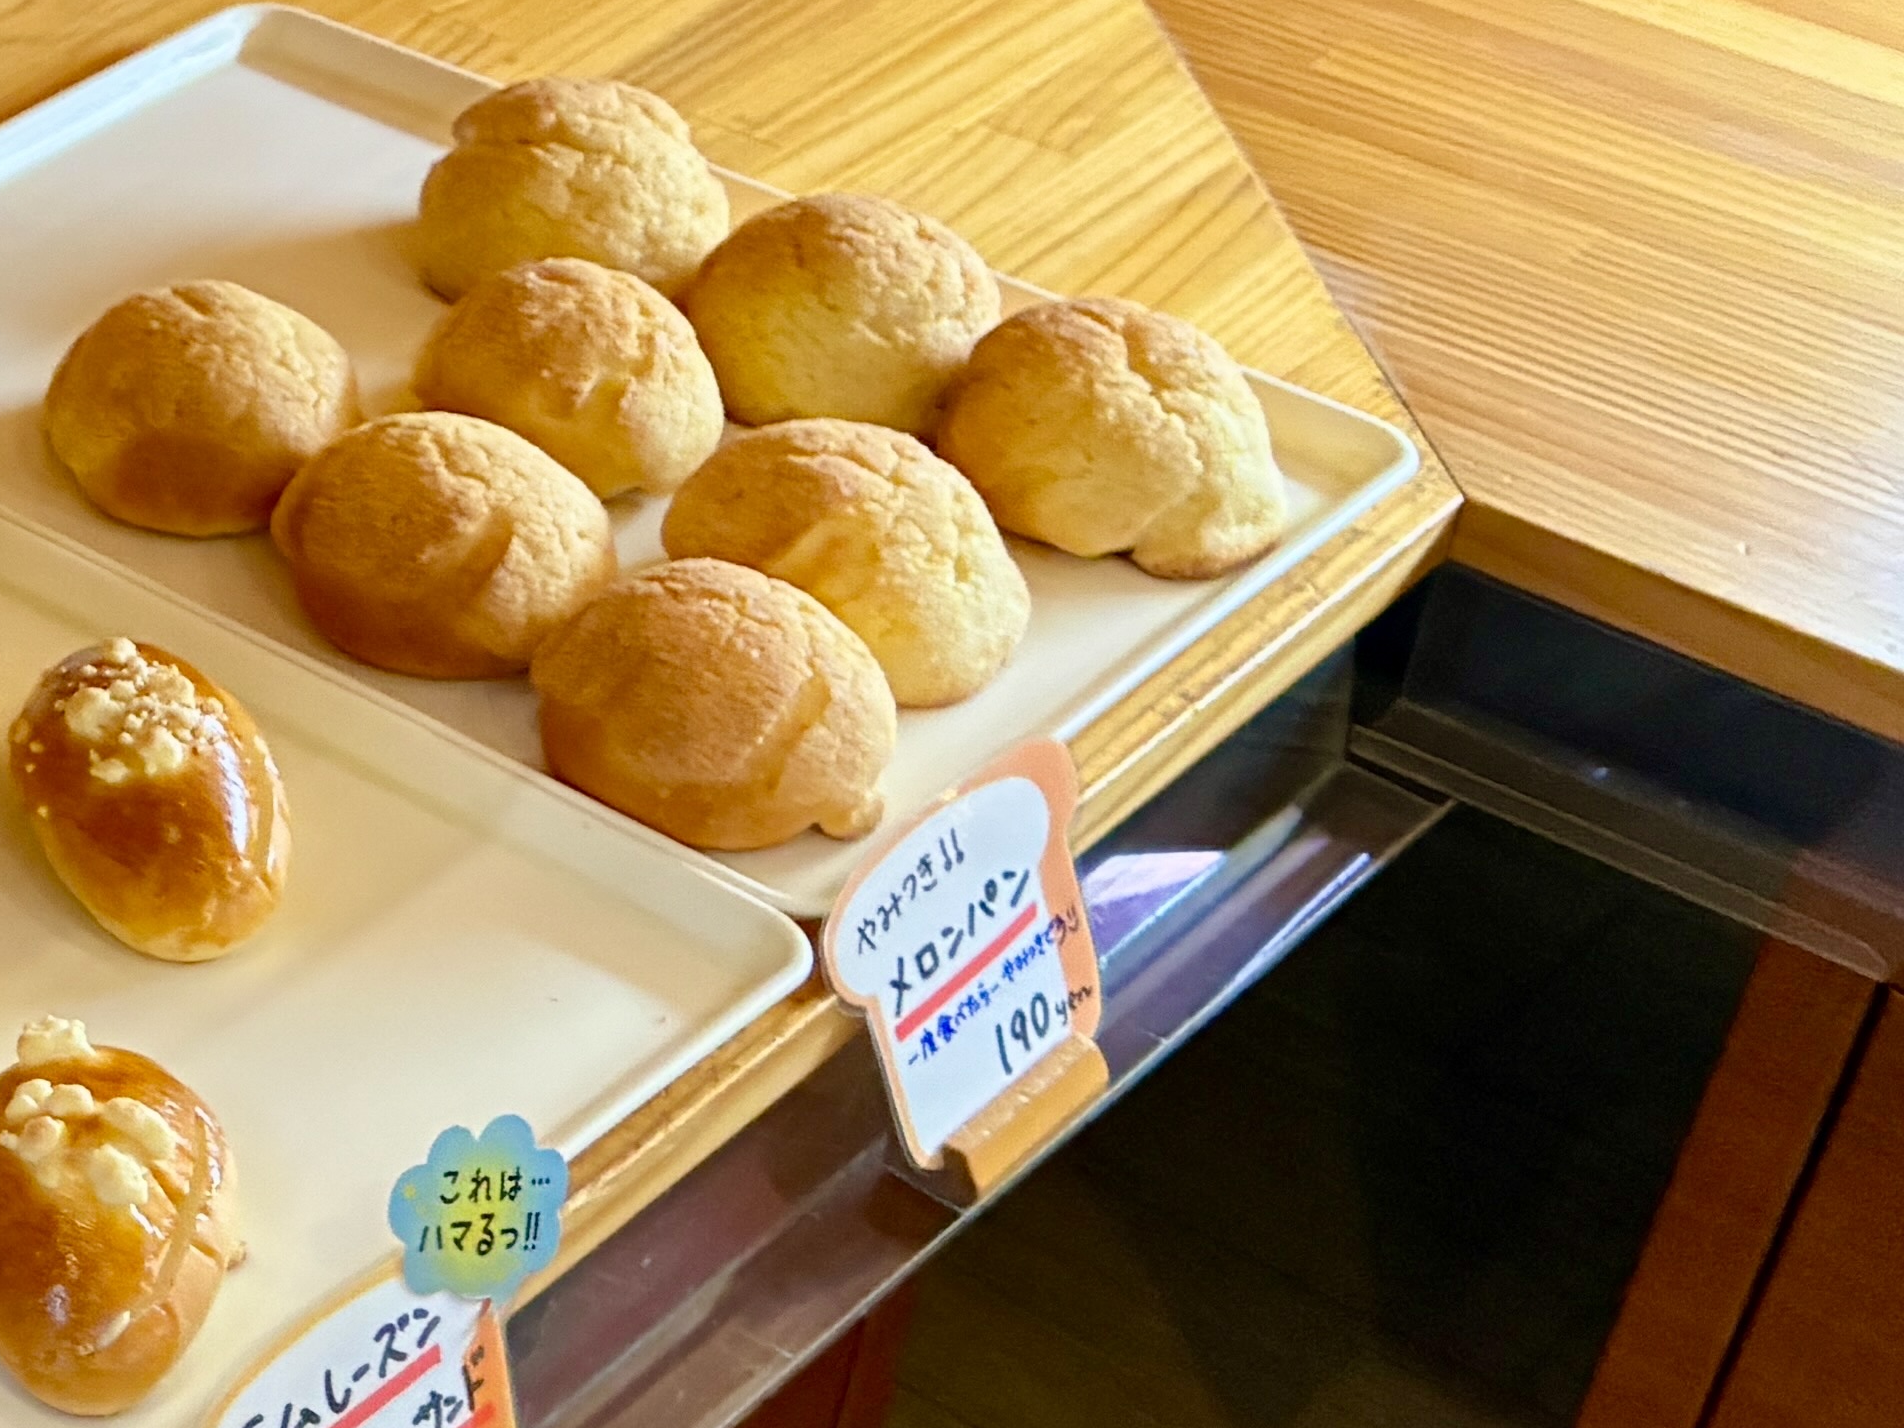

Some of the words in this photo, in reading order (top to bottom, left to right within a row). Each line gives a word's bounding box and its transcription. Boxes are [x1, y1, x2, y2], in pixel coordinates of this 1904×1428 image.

[890, 869, 1030, 1018] メロンパン
[995, 985, 1093, 1075] 190yen
